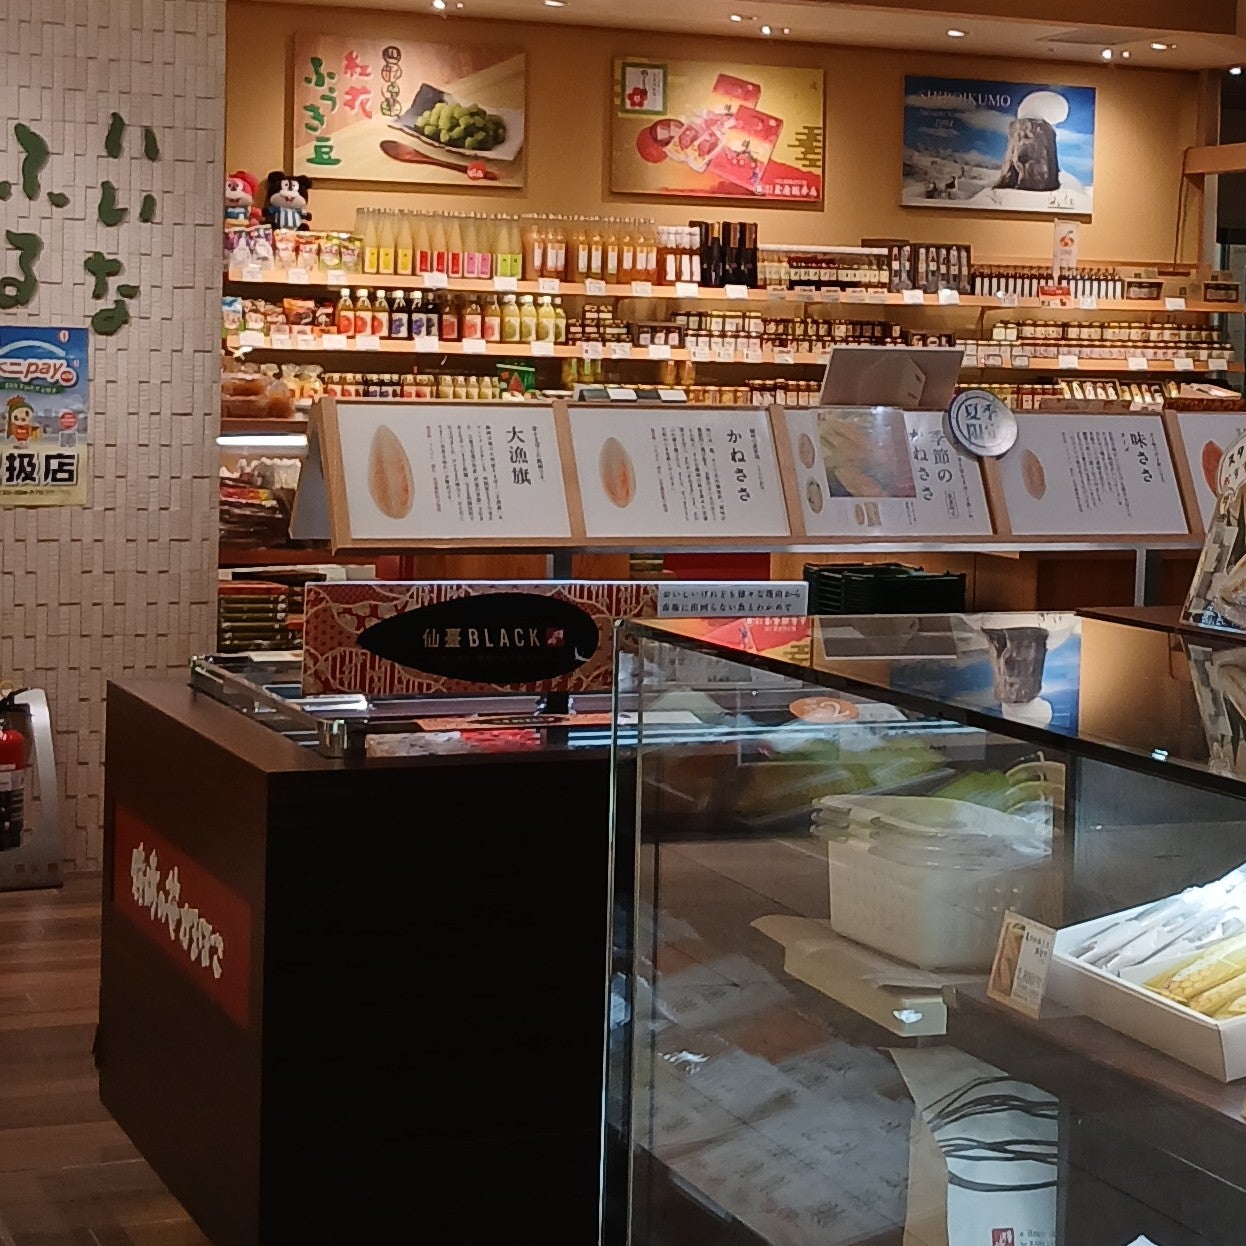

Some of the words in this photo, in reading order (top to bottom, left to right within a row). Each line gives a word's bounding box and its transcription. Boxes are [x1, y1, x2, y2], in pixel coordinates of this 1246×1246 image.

[0, 452, 76, 484] 扱店
[504, 424, 533, 487] 大漁旗
